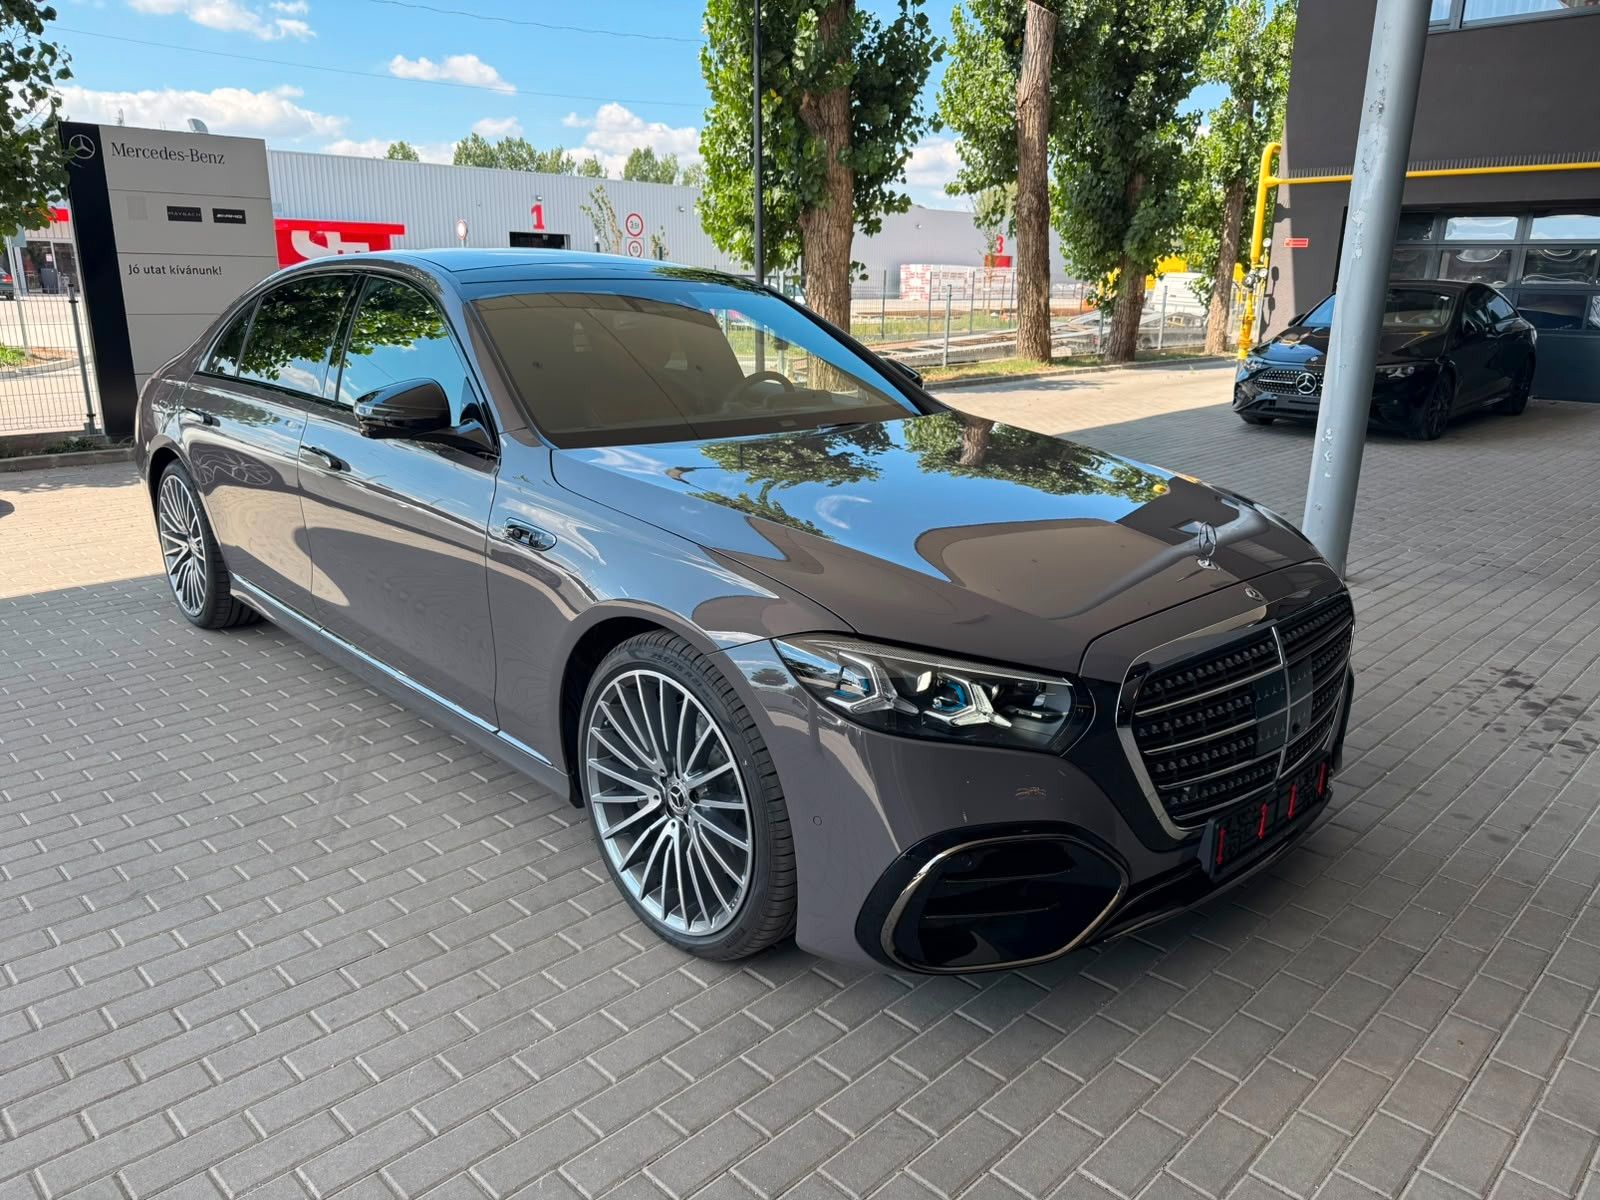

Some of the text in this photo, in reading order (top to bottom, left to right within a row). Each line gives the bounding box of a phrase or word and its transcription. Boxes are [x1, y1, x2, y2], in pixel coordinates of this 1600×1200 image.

[111, 142, 225, 165] Mercedes-Benz
[531, 203, 545, 230] 1
[996, 235, 1004, 254] 3
[128, 264, 222, 275] Jó utat kívánunk!
